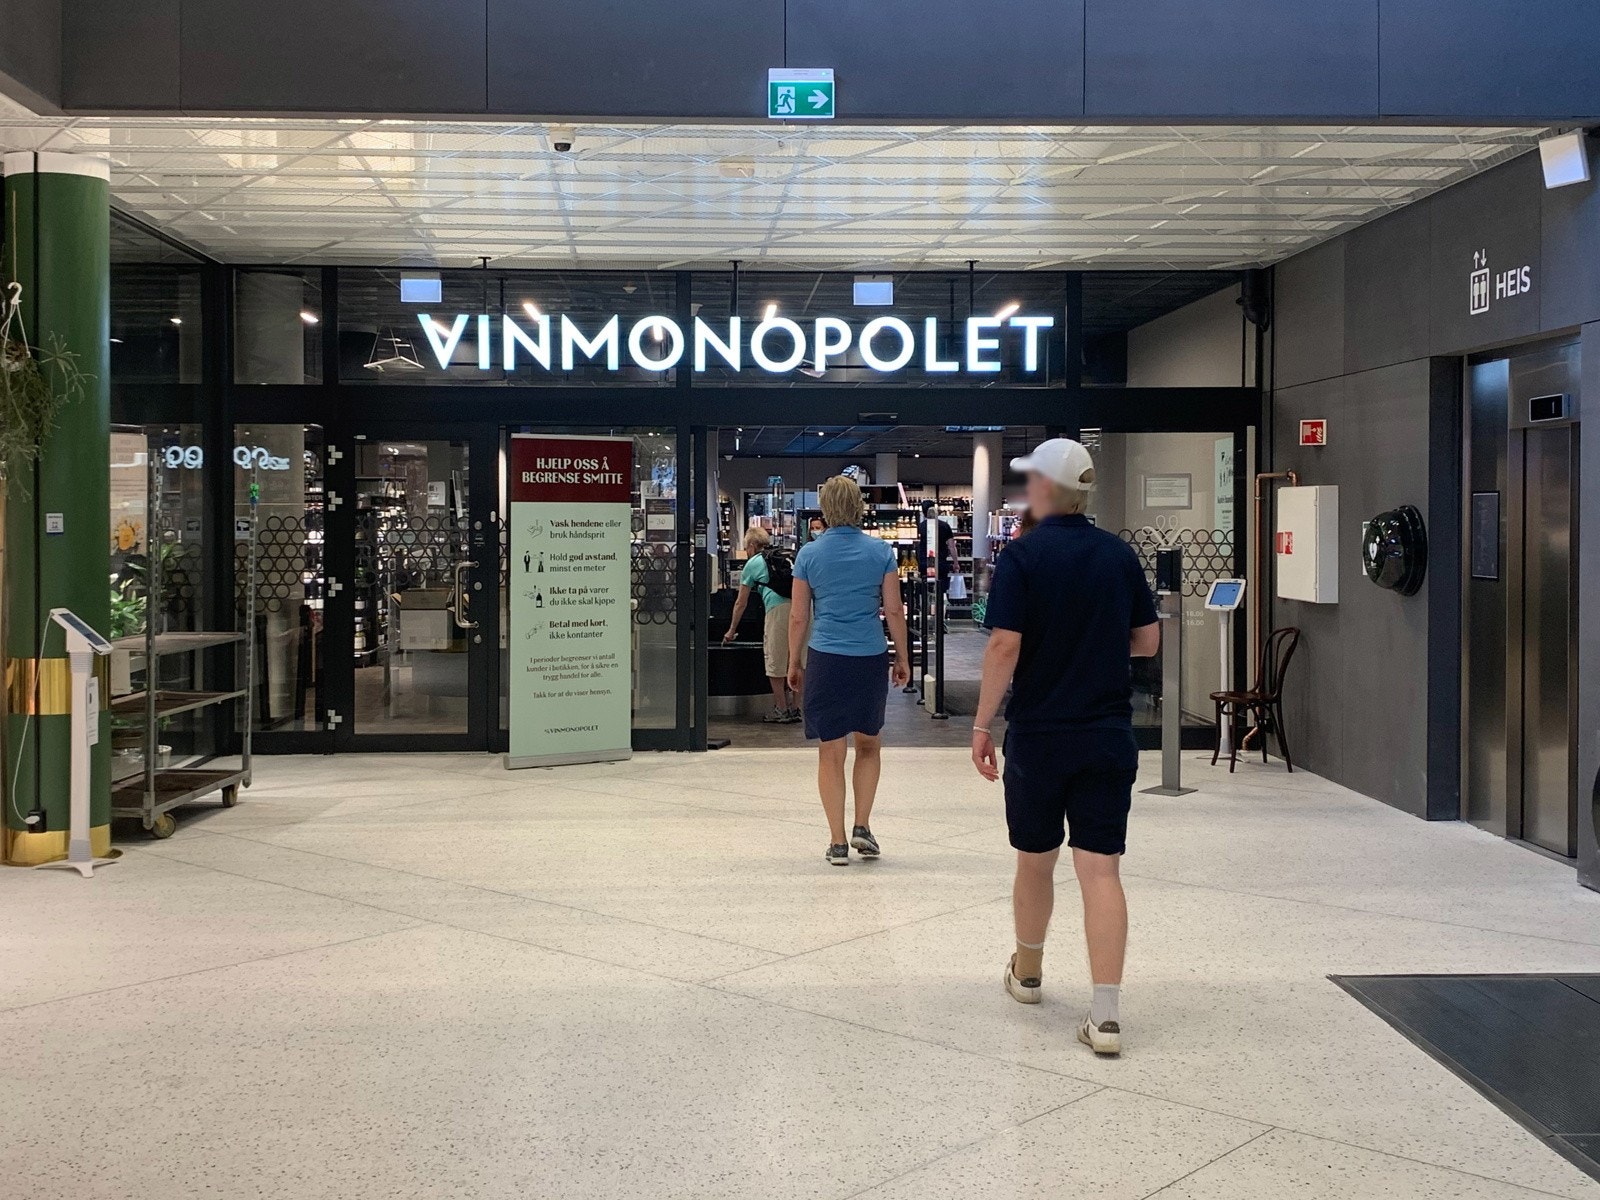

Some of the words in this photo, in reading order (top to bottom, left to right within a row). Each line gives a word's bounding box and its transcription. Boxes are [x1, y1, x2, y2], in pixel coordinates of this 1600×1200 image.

[1496, 266, 1531, 300] HEIS
[417, 313, 1055, 374] VINMONOPOLET
[536, 458, 572, 470] HJELP
[574, 458, 598, 470] OSS
[602, 456, 610, 470] Å
[522, 472, 580, 484] BEGRENSE
[583, 472, 624, 484] SMITTE
[550, 530, 568, 539] bruk
[569, 530, 605, 540] håndsprit
[550, 553, 568, 561] Hold
[569, 553, 584, 563] god
[550, 564, 572, 572] minst
[578, 586, 588, 596] på
[549, 598, 560, 606] du
[560, 598, 577, 606] ikke
[594, 597, 616, 607] kjøpe
[533, 656, 560, 664] perioder
[550, 724, 599, 733] VINMONOPOLET
